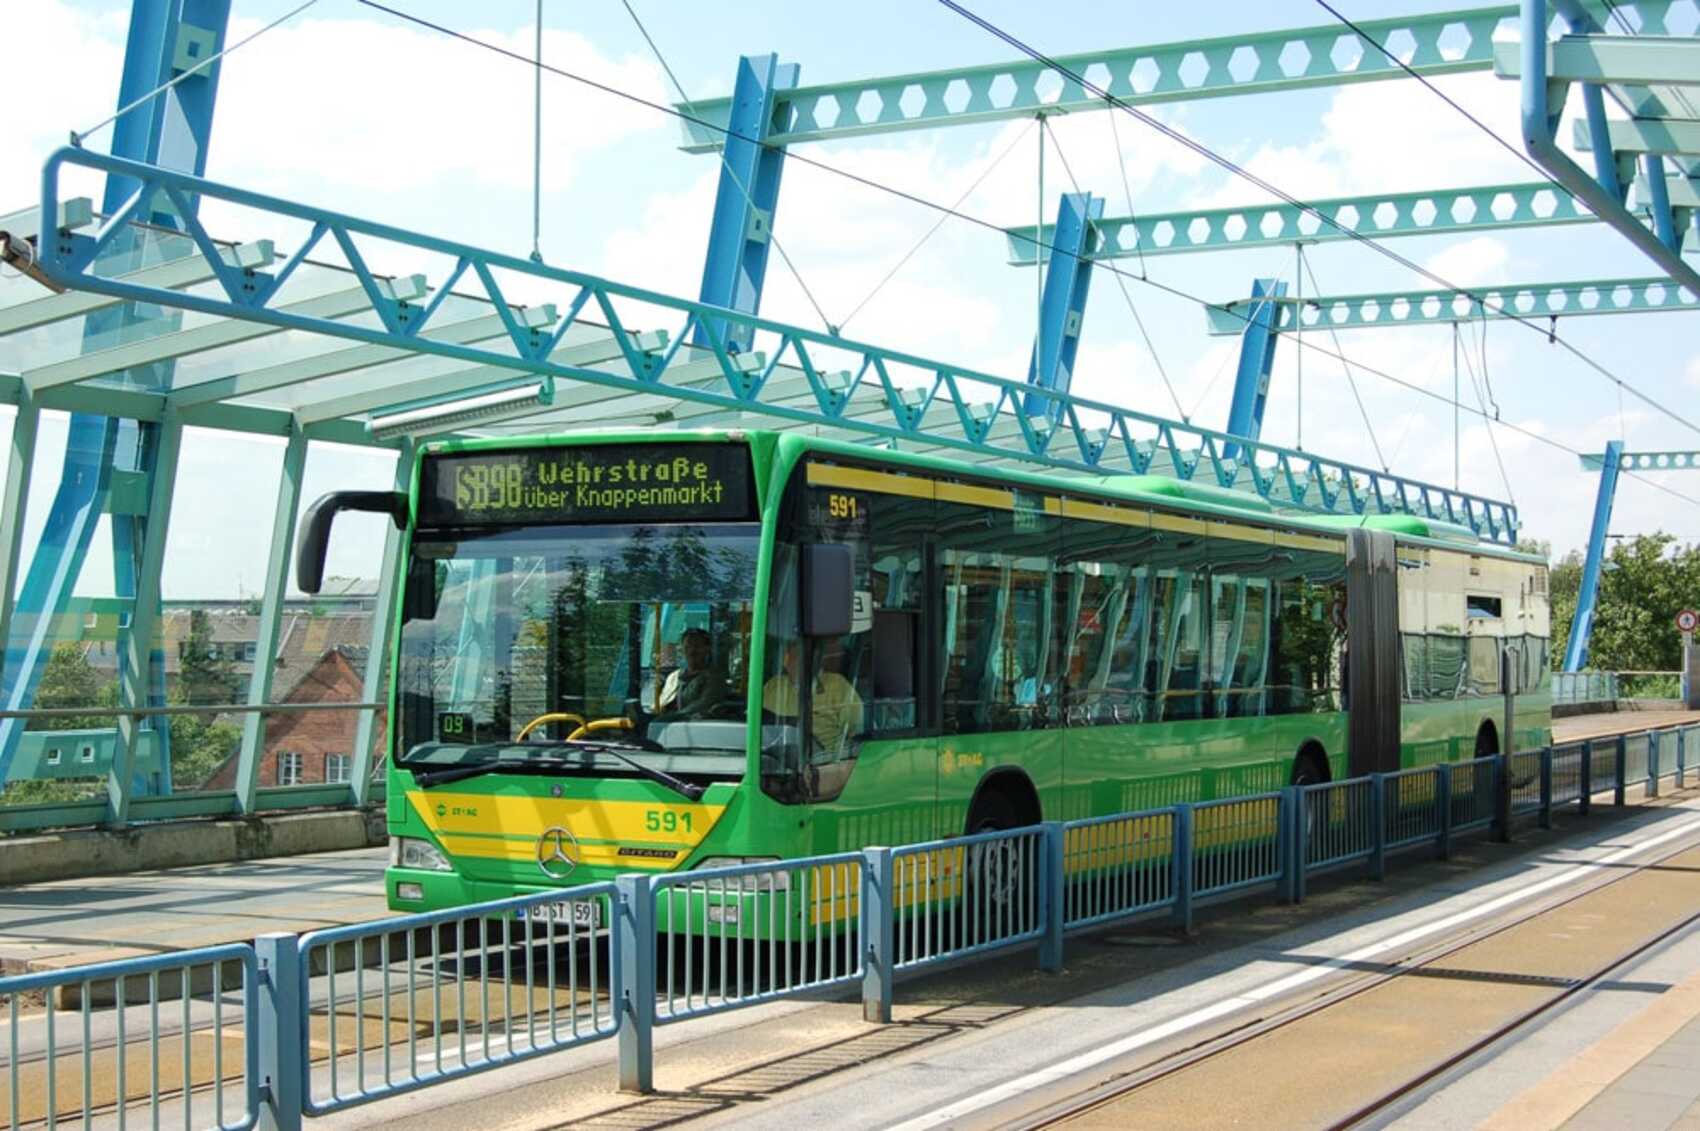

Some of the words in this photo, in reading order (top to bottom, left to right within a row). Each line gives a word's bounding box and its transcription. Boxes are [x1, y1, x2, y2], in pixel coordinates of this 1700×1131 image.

[538, 457, 709, 485] Wehrstraße
[524, 484, 569, 509] über
[575, 480, 723, 509] Knappenmarkt
[829, 494, 857, 519] 591
[443, 714, 465, 734] 09
[646, 810, 693, 833] 591
